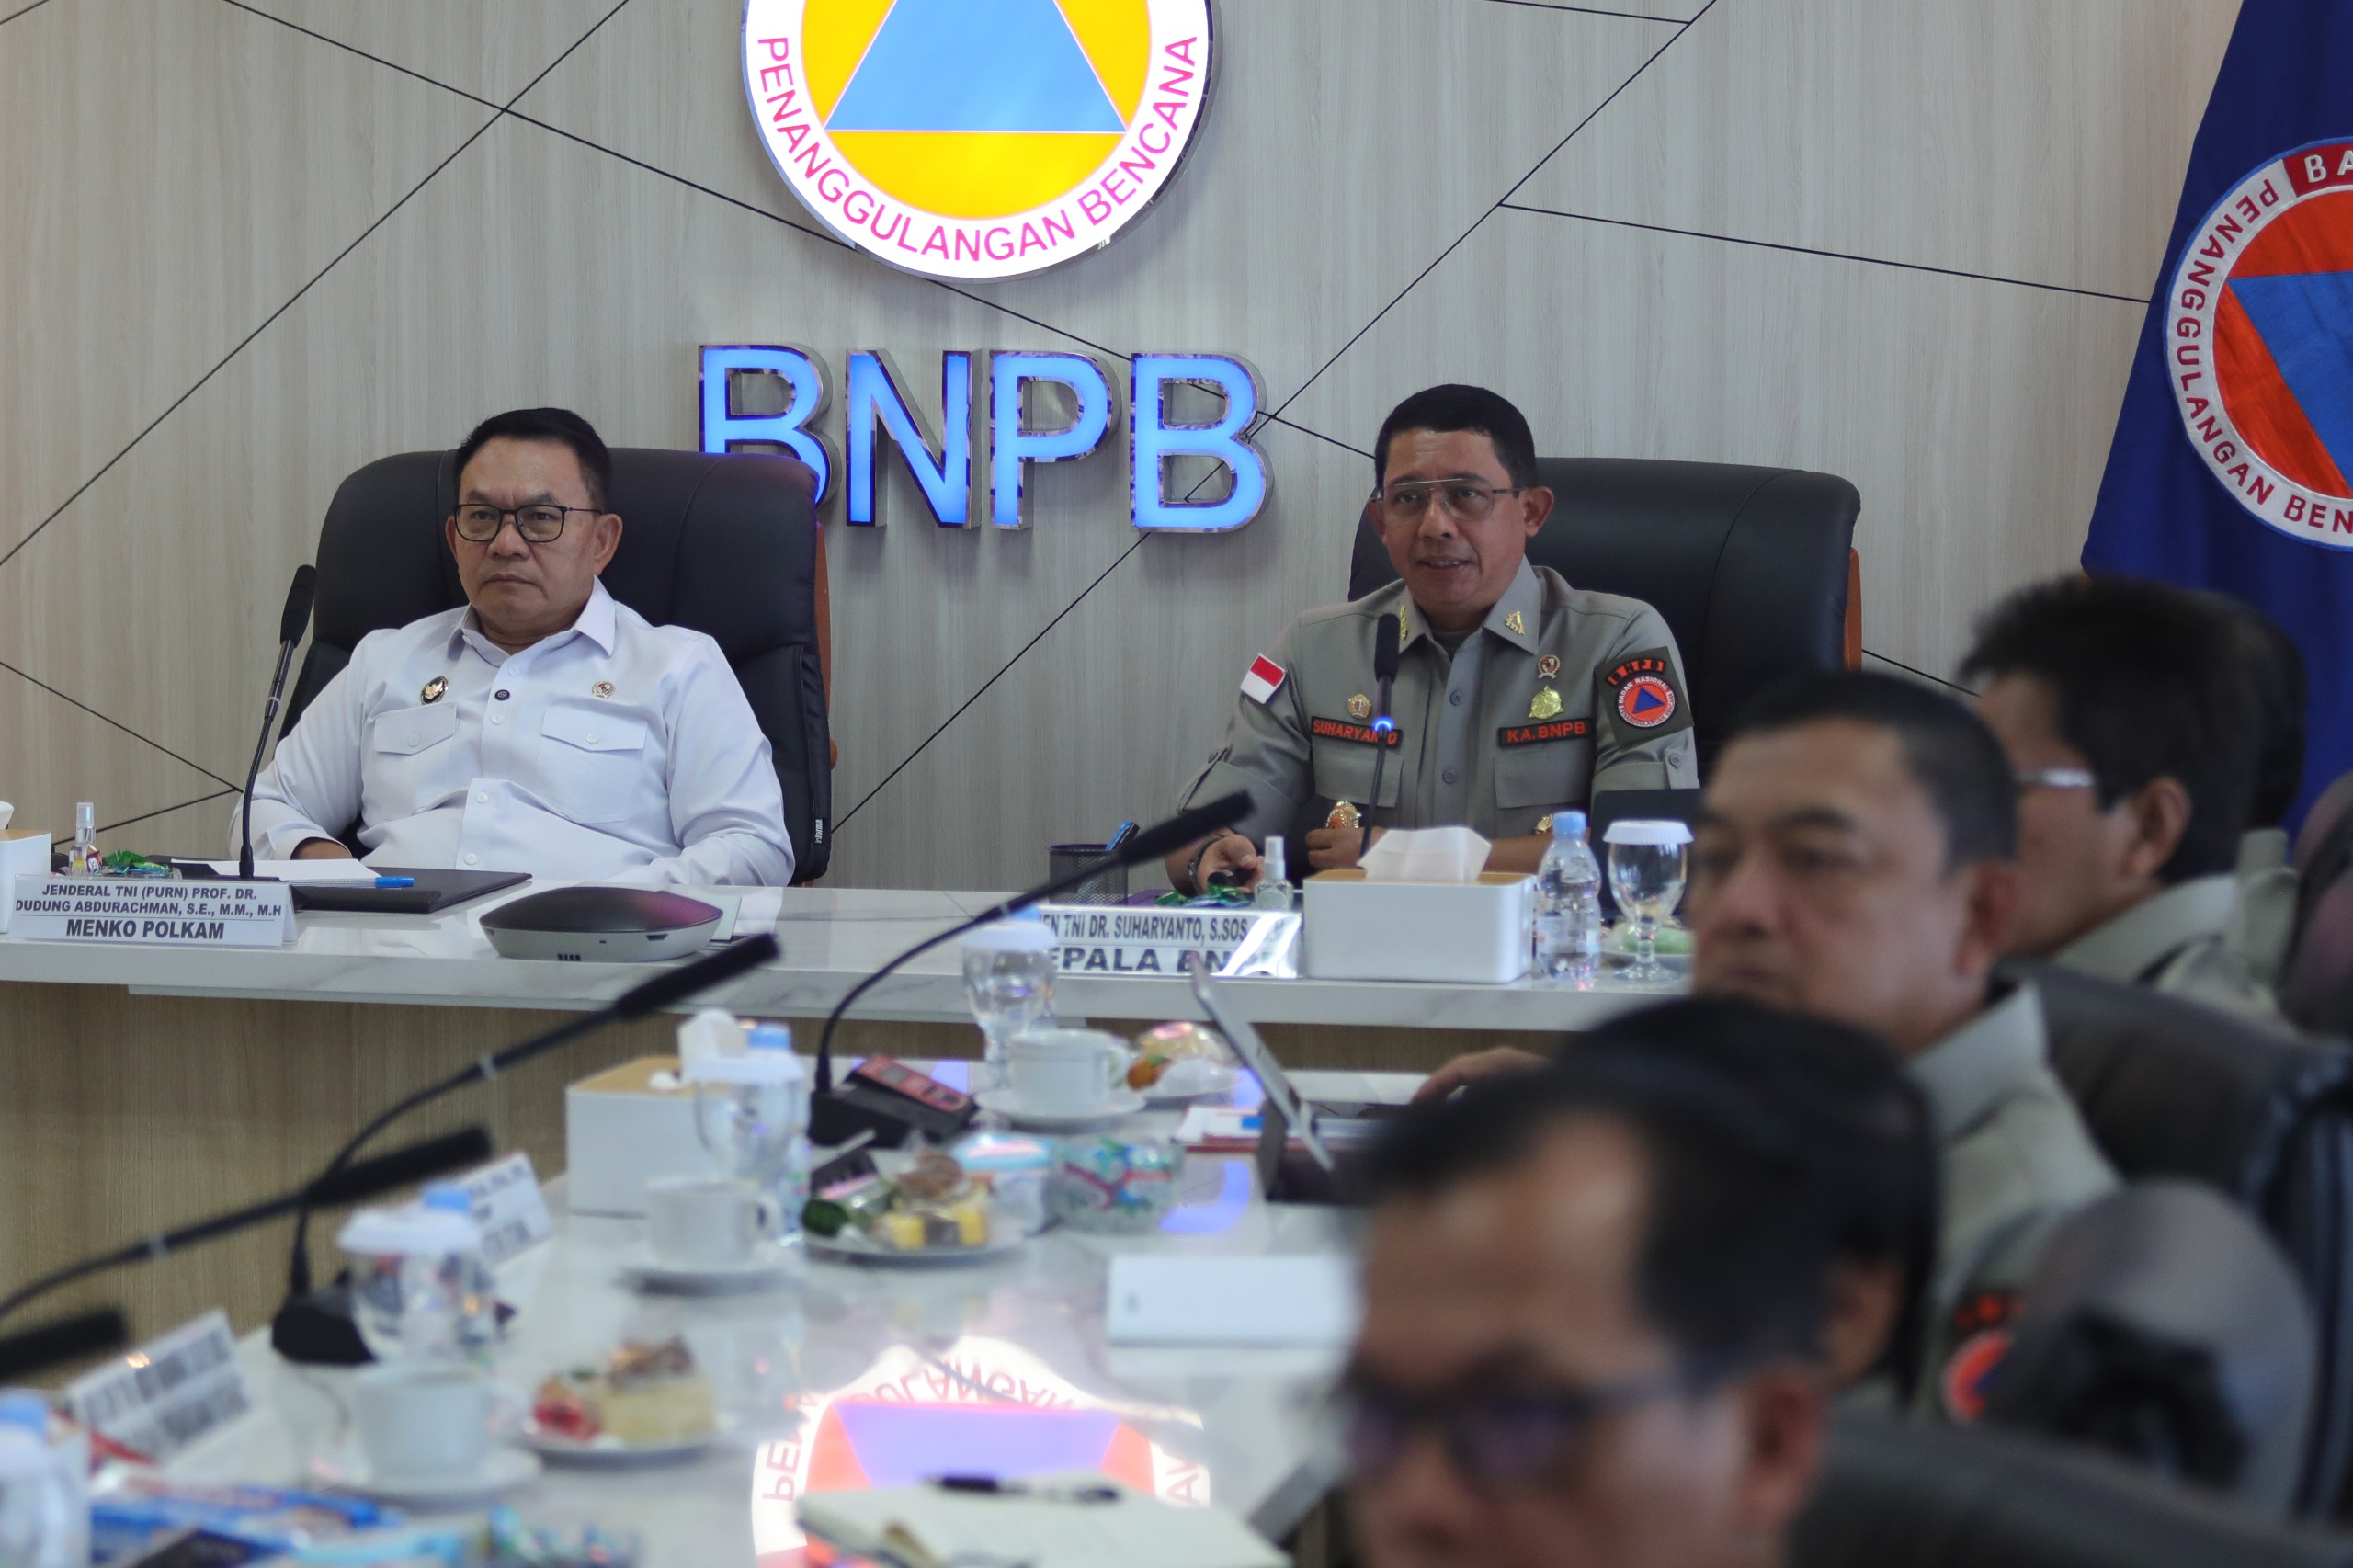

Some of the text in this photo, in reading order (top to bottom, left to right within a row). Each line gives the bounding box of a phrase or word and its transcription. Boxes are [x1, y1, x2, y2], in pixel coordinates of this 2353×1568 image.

[757, 35, 1199, 262] PENANGGULANGAN BENCANA
[2176, 179, 2280, 506] PENANGGULANGAN
[698, 344, 1272, 531] BNPB
[1313, 719, 1397, 745] SUHARYANO
[41, 884, 257, 901] JENDERAL TNI (PURN) PROF. DR.
[16, 900, 282, 918] DUDUNG ABDURACHMAN, S.E., M.M., M.H
[66, 919, 225, 939] MENKO POLKAM
[1064, 915, 1085, 937] TNI
[1088, 915, 1110, 938] DR.
[1113, 916, 1205, 947] SUHARYANTO,
